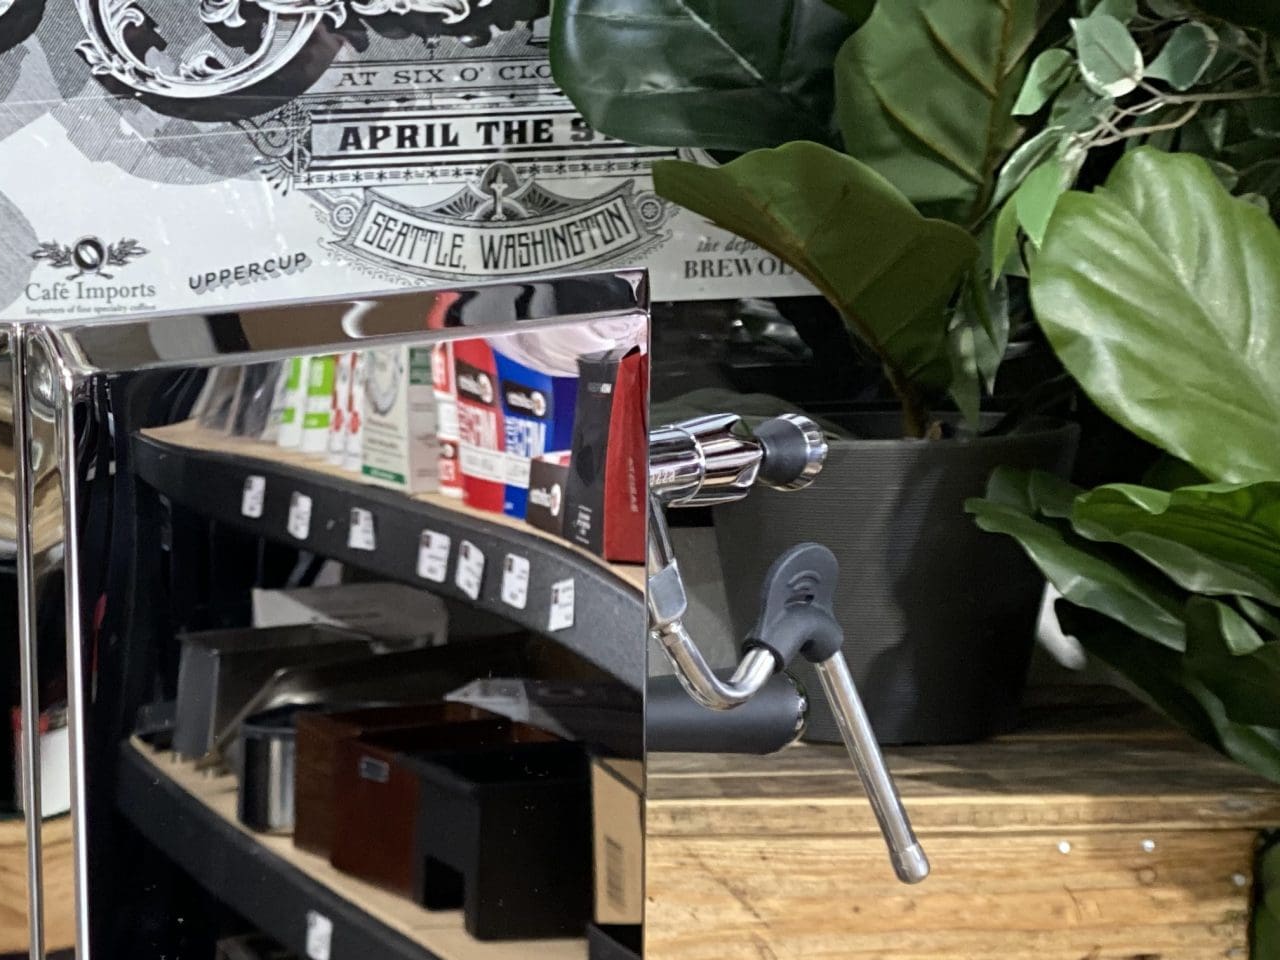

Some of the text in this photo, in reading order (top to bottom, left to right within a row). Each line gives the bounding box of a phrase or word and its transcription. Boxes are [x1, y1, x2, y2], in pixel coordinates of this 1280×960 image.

[336, 71, 378, 87] AT
[393, 69, 445, 84] SIX
[339, 122, 459, 151] APRIL
[477, 118, 554, 145] THE
[363, 198, 632, 271] SEATTLE, WASHINGTON
[188, 251, 308, 291] UPPERCUP
[25, 281, 157, 304] Café Imports
